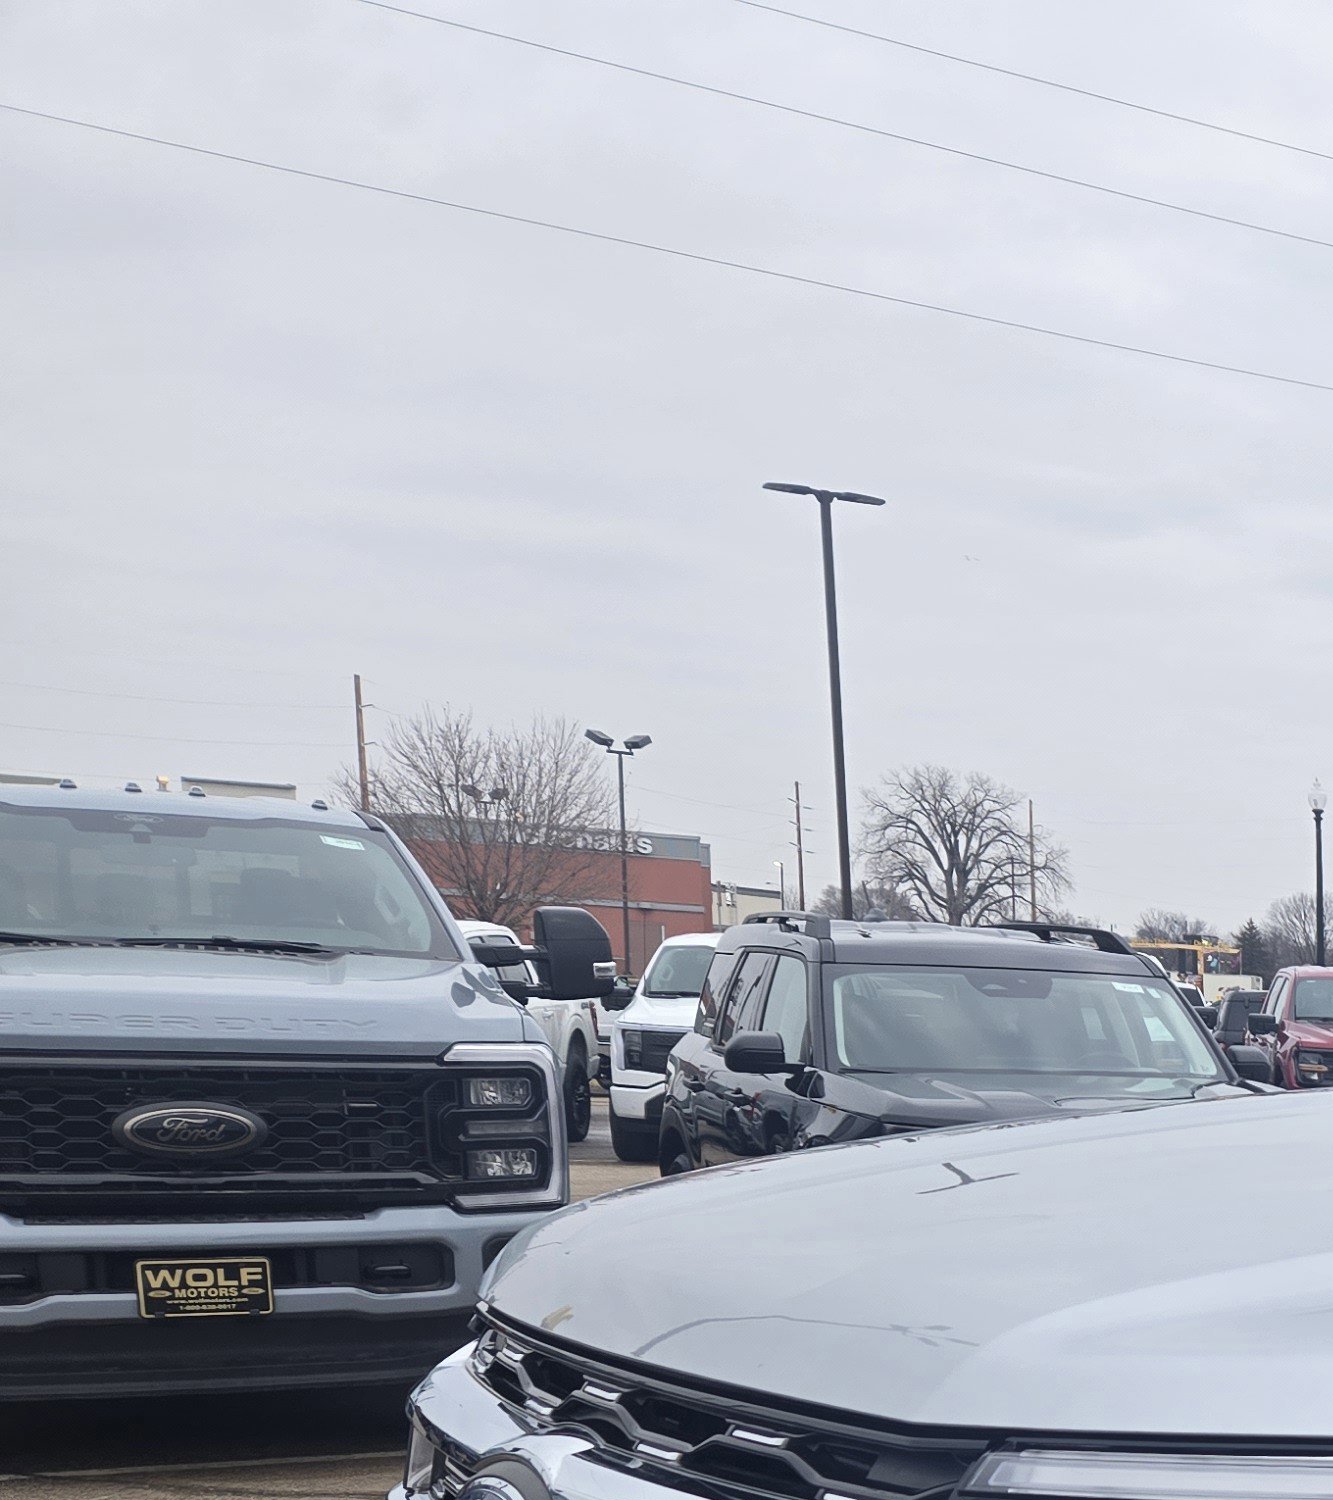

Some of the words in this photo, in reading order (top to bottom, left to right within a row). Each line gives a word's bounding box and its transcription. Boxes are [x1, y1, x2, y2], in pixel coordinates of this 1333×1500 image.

[155, 1116, 226, 1143] Ford
[144, 1267, 263, 1289] WOLF
[174, 1286, 239, 1298] MOTORS
